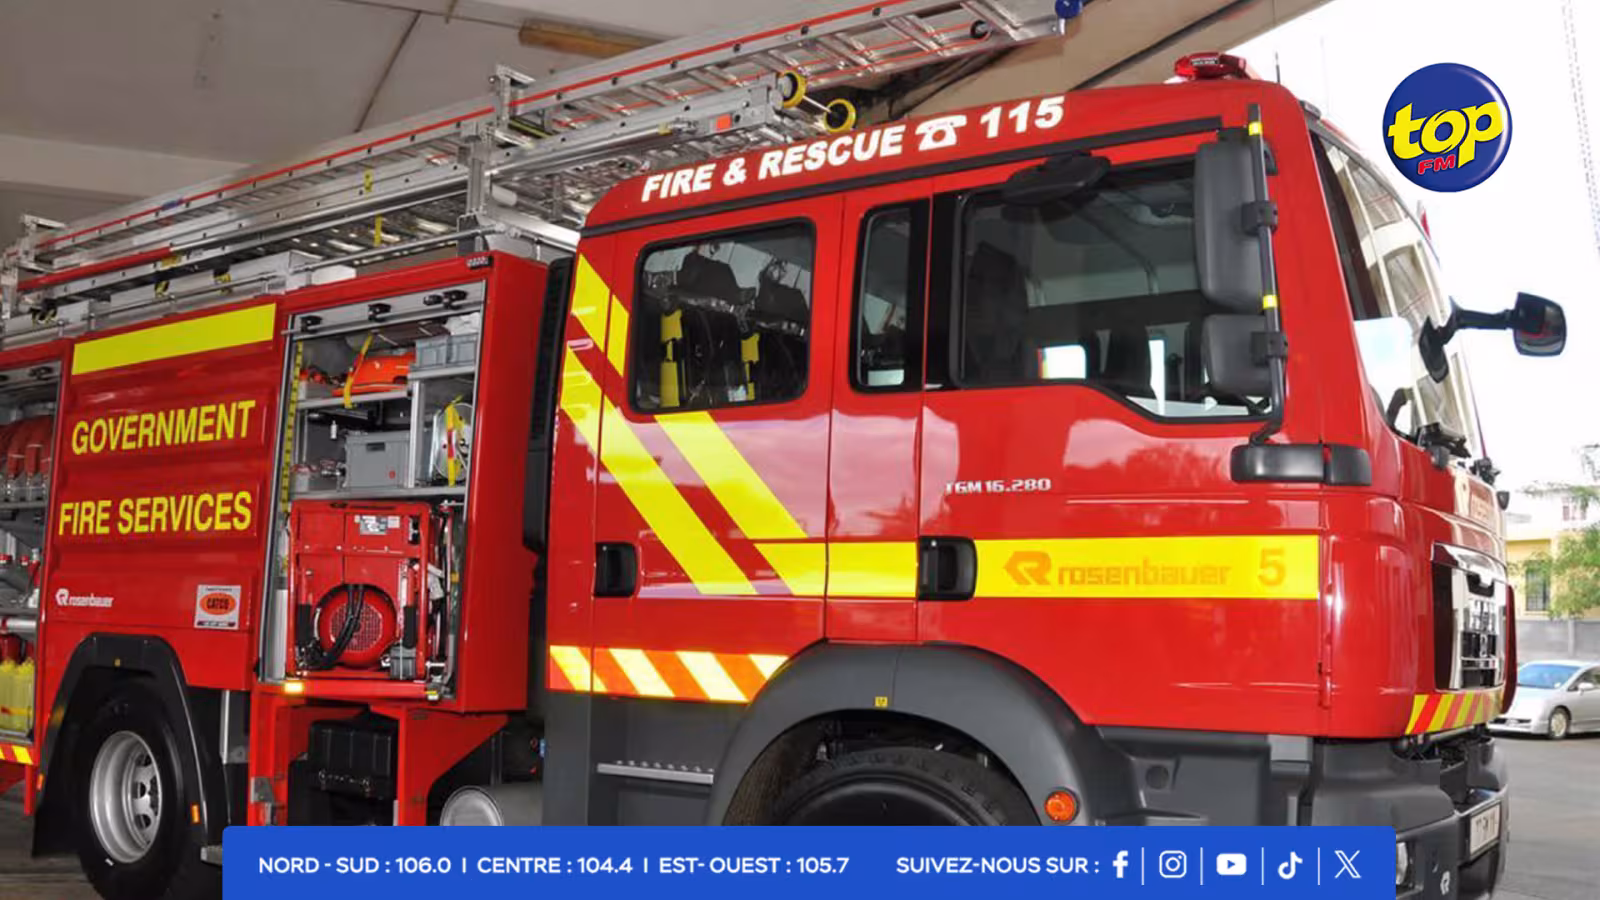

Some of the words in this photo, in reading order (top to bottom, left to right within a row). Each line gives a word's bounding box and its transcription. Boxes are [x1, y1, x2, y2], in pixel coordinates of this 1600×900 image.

[641, 163, 716, 202] FIRE
[722, 157, 747, 186] &
[758, 125, 906, 180] RESCUE
[980, 96, 1066, 139] 115
[72, 400, 256, 455] GOVERNMENT
[945, 480, 982, 494] TGM
[985, 478, 1052, 493] 16.280
[58, 500, 112, 536] FIRE
[117, 491, 252, 534] SERVICES
[1058, 555, 1232, 586] rosenbauer
[1258, 548, 1286, 587] 5
